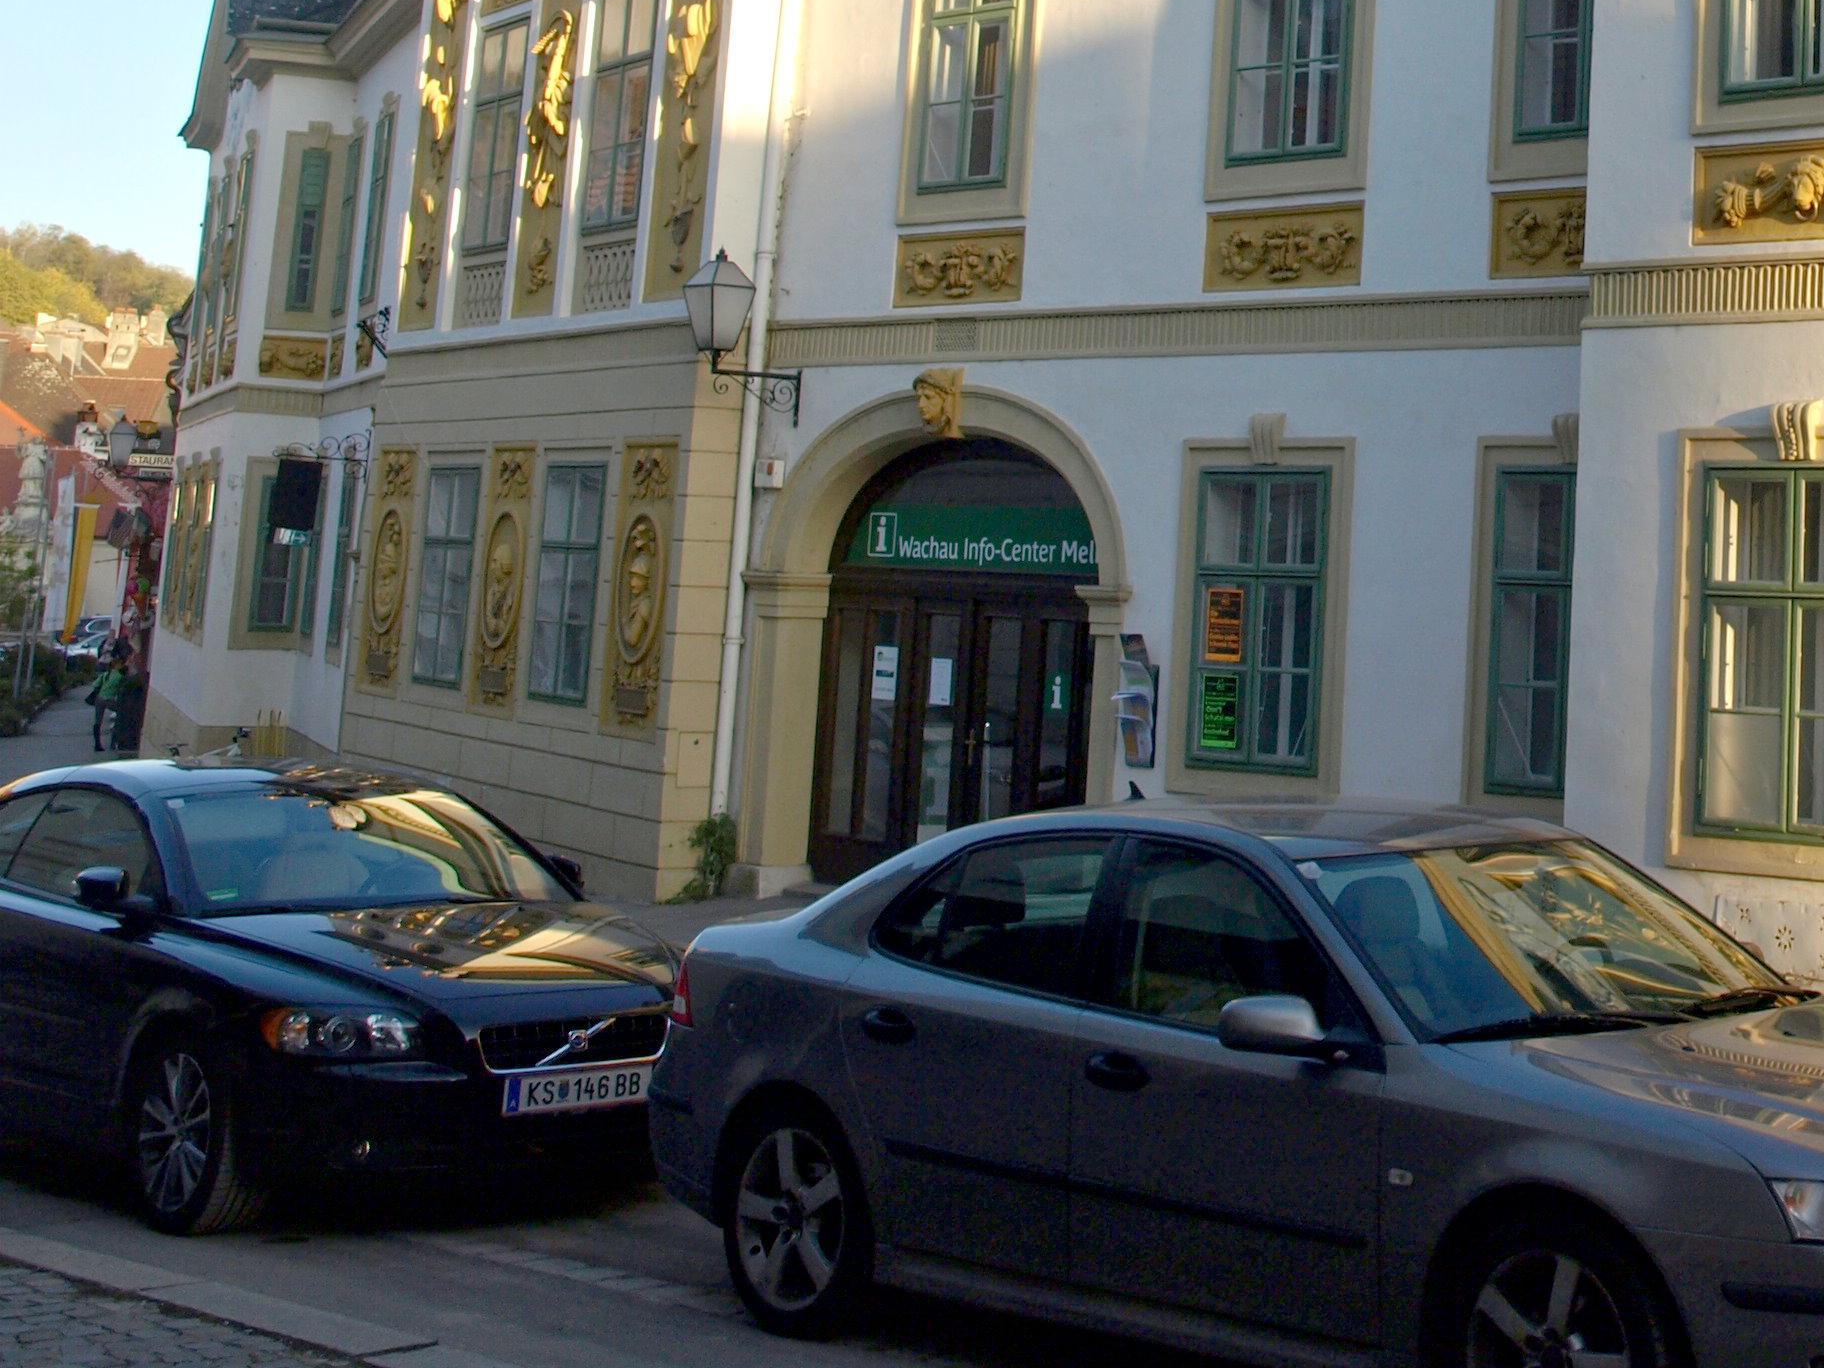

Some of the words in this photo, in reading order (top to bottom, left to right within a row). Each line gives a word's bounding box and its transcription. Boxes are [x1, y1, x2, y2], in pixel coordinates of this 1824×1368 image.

[899, 536, 959, 560] Wachau
[964, 537, 1057, 566] Info-Center
[527, 1081, 555, 1106] KS
